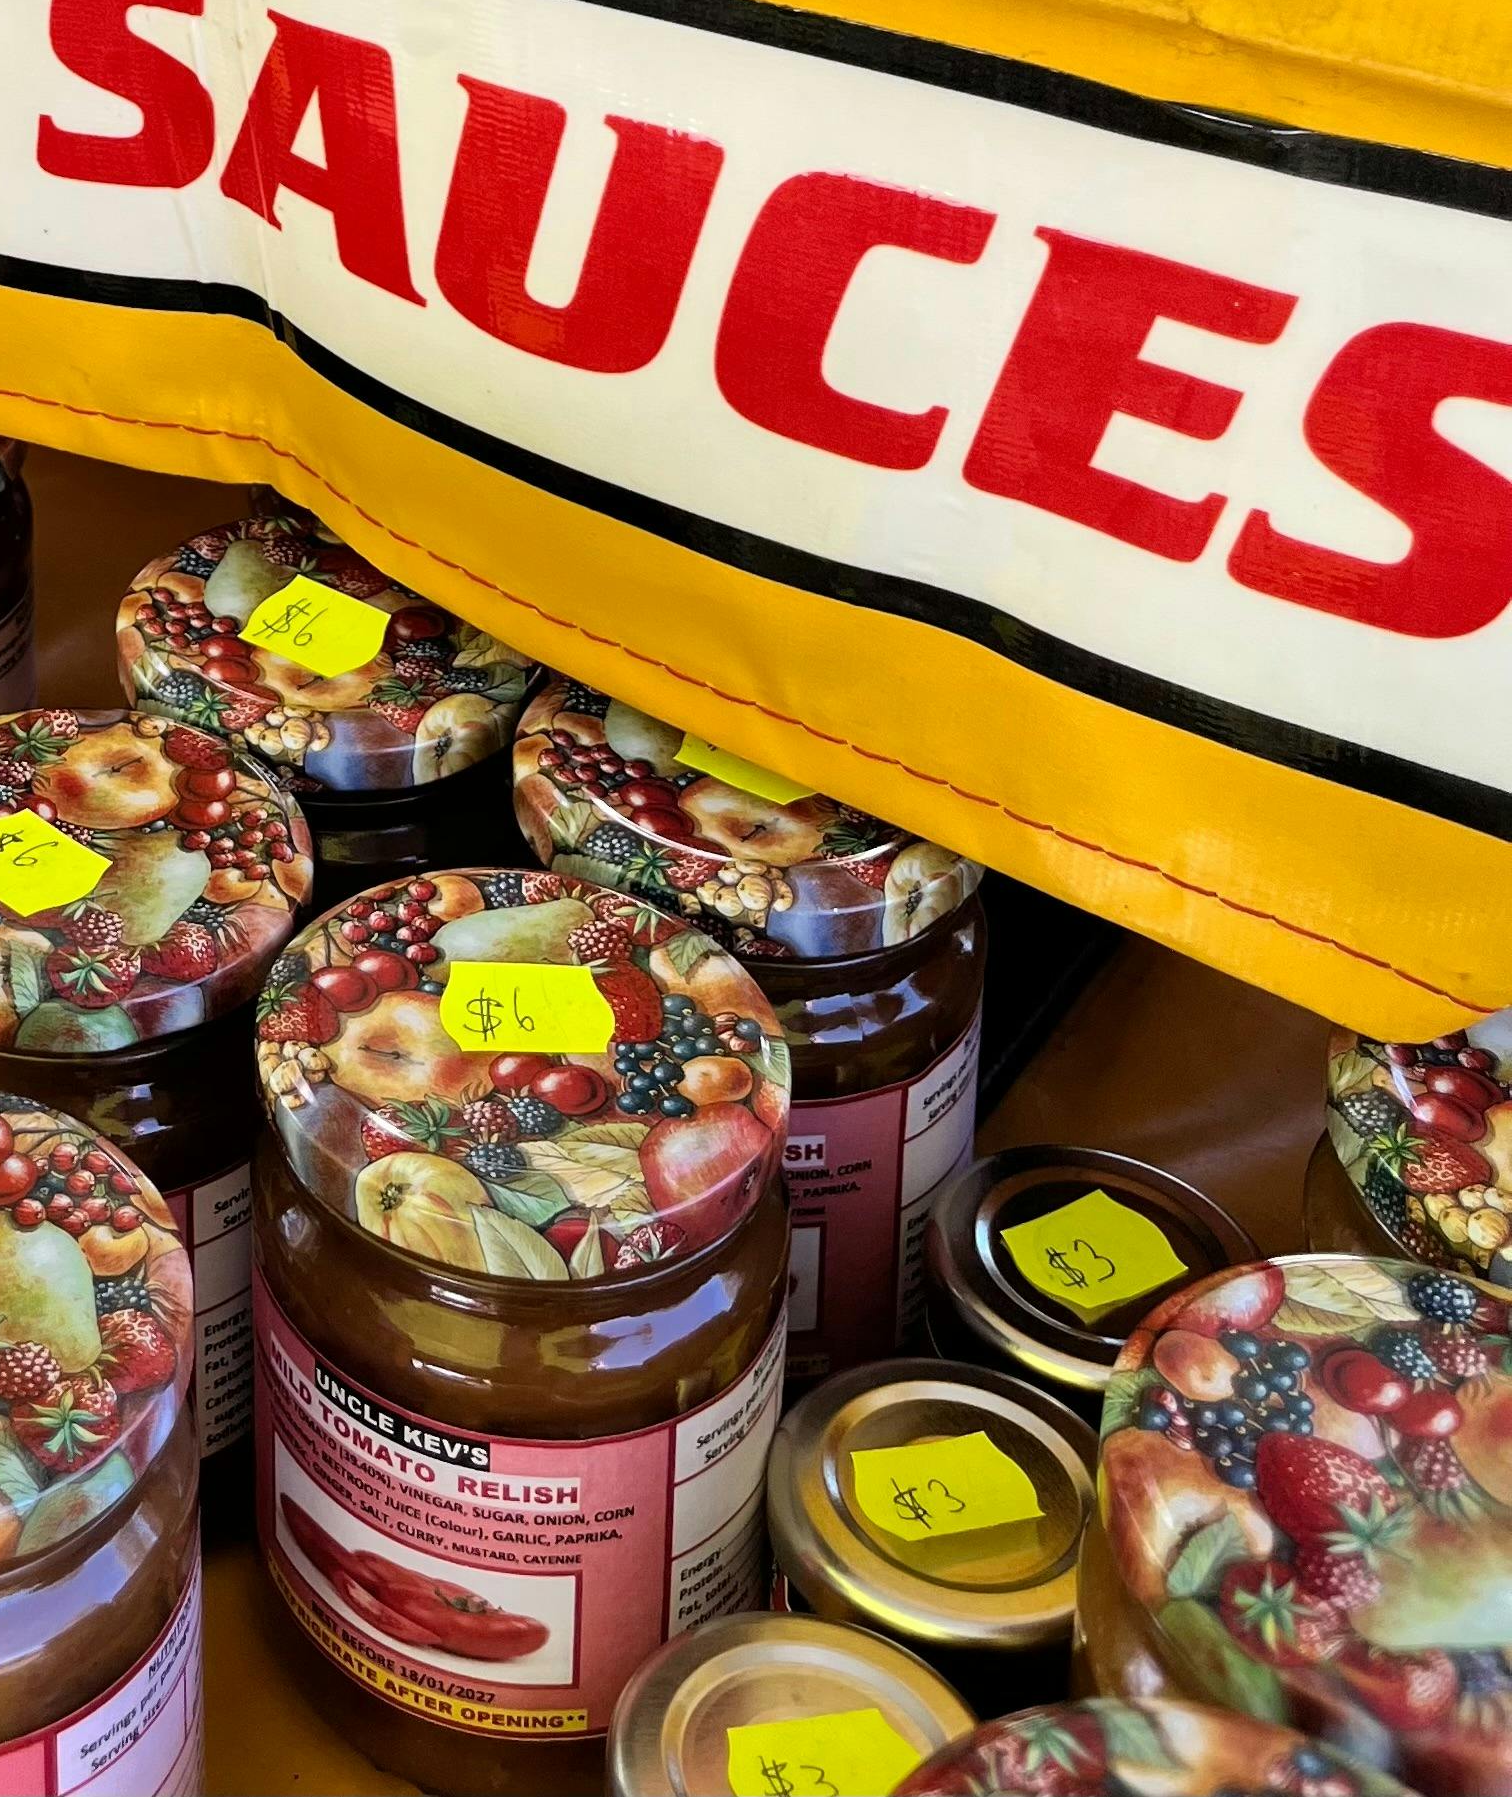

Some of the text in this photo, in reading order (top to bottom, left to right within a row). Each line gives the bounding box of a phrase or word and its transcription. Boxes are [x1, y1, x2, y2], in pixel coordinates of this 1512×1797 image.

[253, 598, 328, 646] $6
[463, 987, 535, 1042] $6
[1046, 1239, 1115, 1288] $3
[271, 1339, 578, 1504] MILD TOMATO RELISH
[315, 1367, 489, 1466] UNCLE KEV'S
[400, 1483, 636, 1526] VINEGAR, SUGAR, ONION, CORN
[891, 1478, 965, 1529] $3
[452, 1541, 582, 1565] MUSTARD, CAYENNE
[493, 1528, 622, 1546] GARLIC, PAPRIKA,
[384, 1678, 453, 1720] AFTER
[399, 1665, 496, 1705] 18/01/2027
